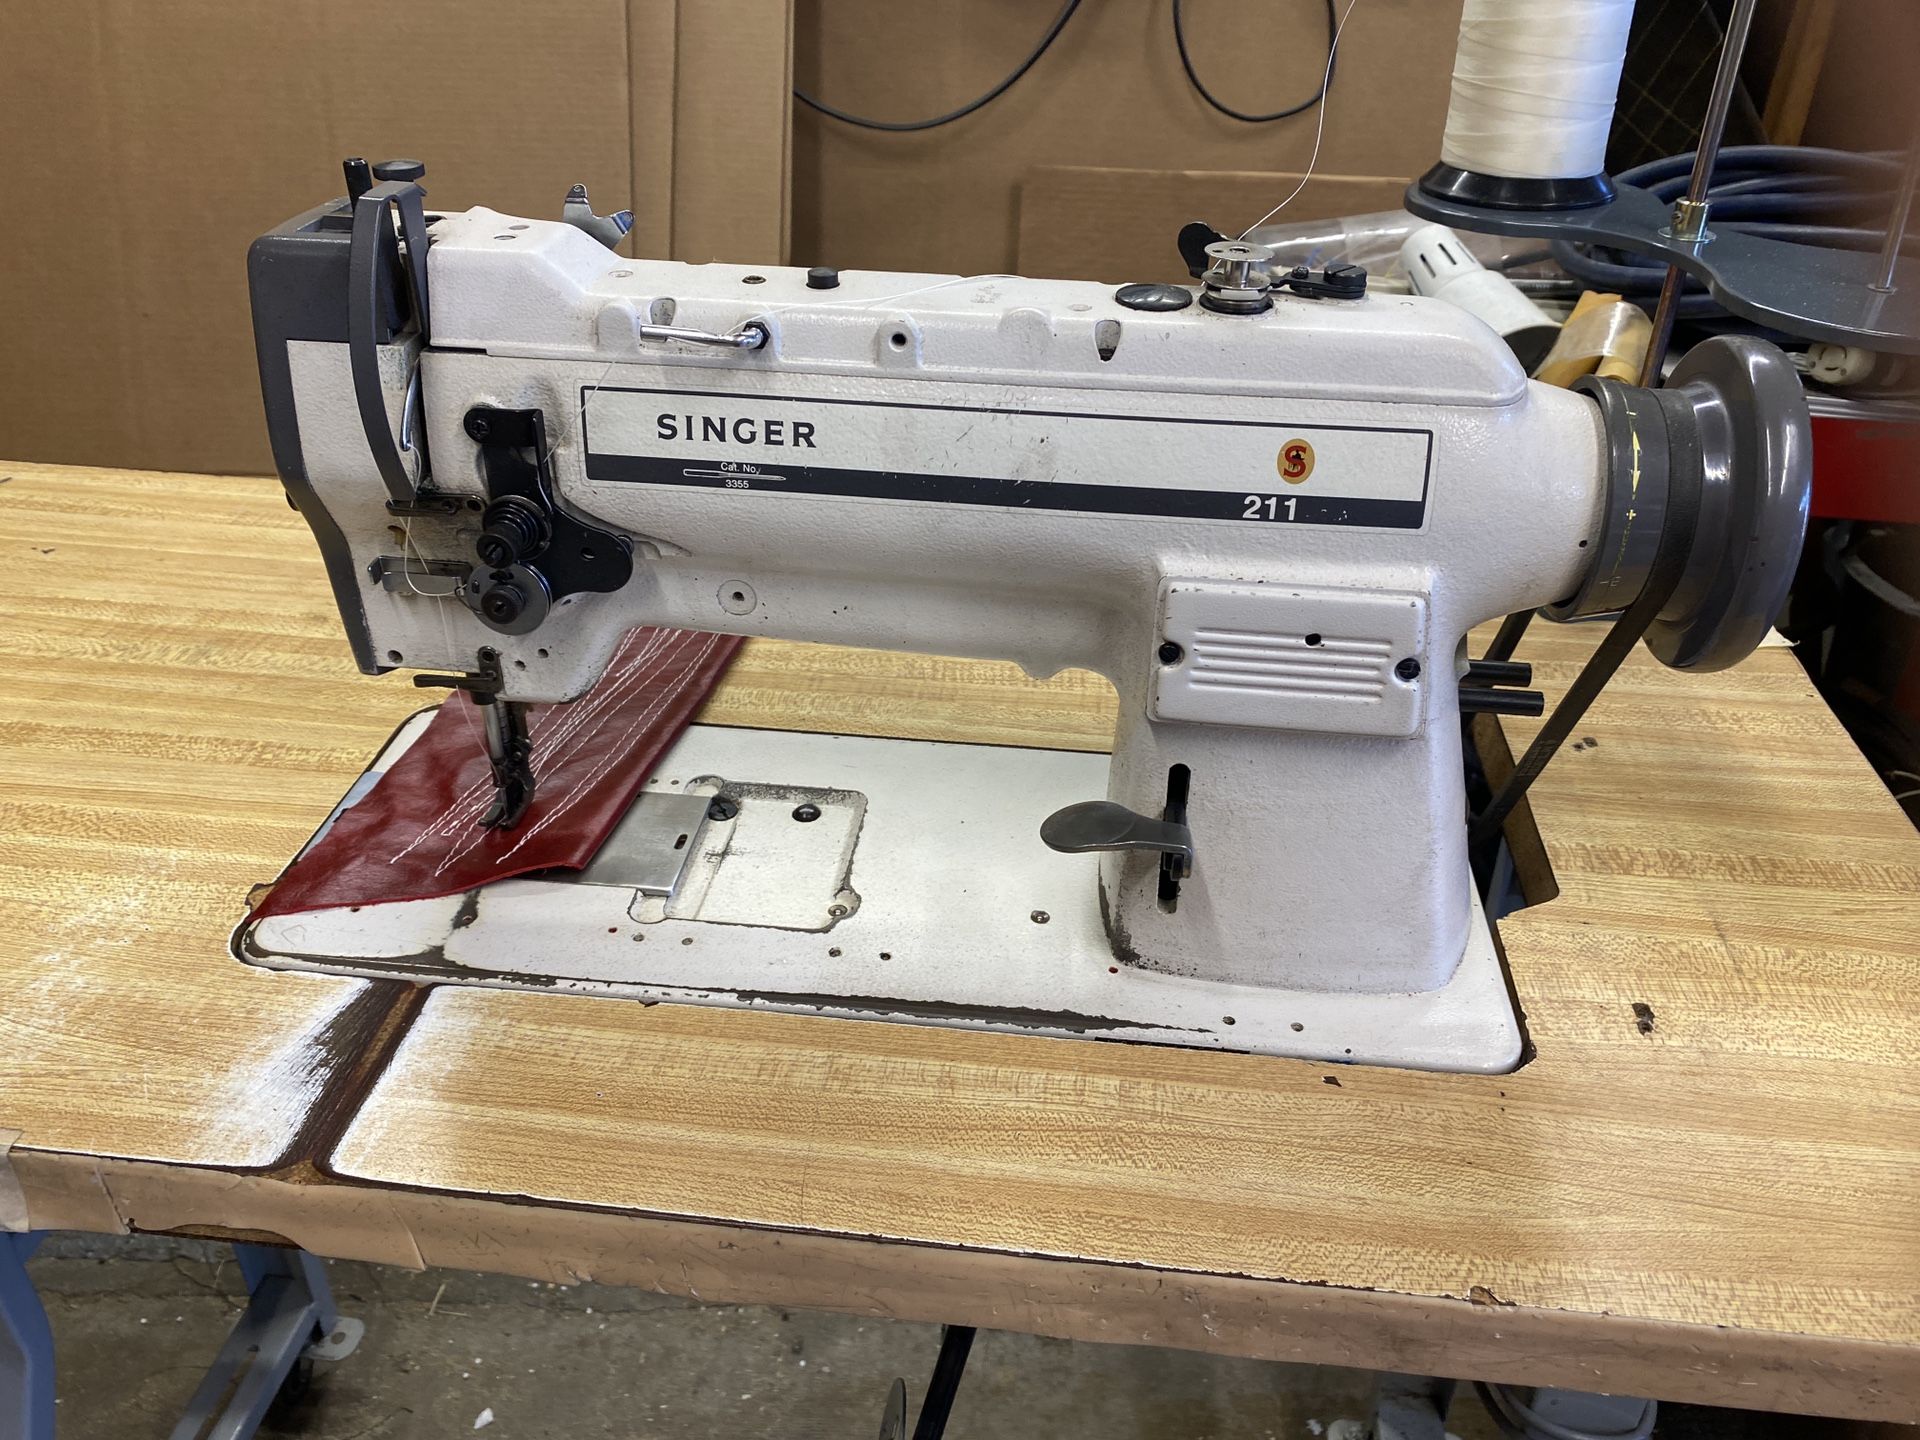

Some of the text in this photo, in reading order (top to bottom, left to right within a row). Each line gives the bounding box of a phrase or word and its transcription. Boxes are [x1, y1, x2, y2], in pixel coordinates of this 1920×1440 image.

[656, 413, 817, 448] SINGER
[720, 462, 740, 472] Cat.
[725, 479, 750, 489] 3355
[1242, 495, 1297, 521] 211
